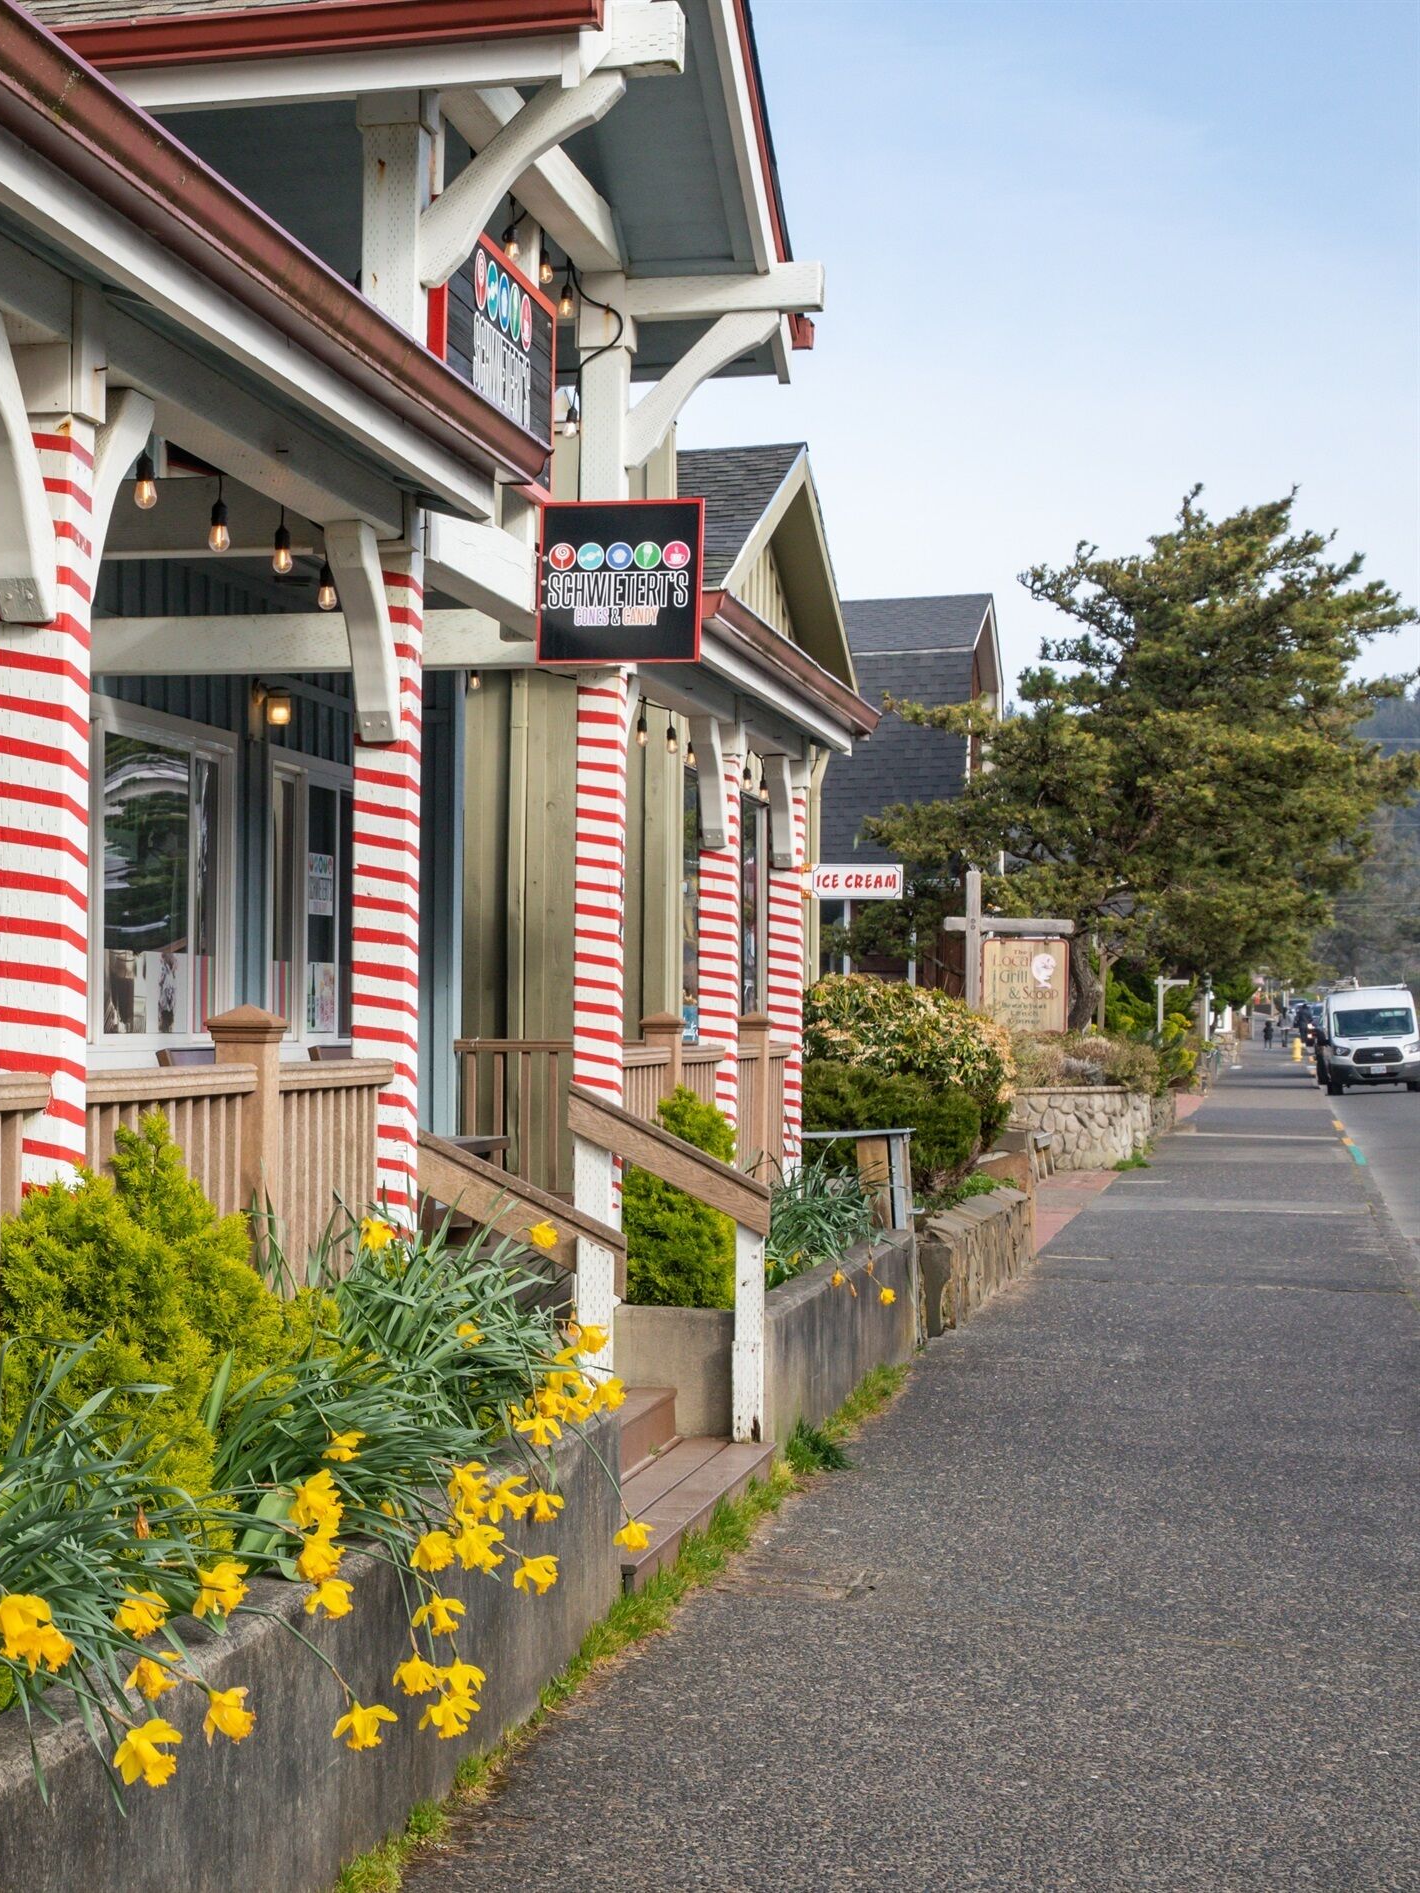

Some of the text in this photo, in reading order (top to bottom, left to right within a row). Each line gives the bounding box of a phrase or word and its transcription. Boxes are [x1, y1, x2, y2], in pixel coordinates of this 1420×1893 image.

[548, 570, 689, 609] SCHWIETERT'S
[574, 606, 659, 626] CONES & CANDY
[816, 873, 897, 889] ICE CREAM
[1000, 969, 1028, 984] Grill
[1009, 986, 1021, 1000] &
